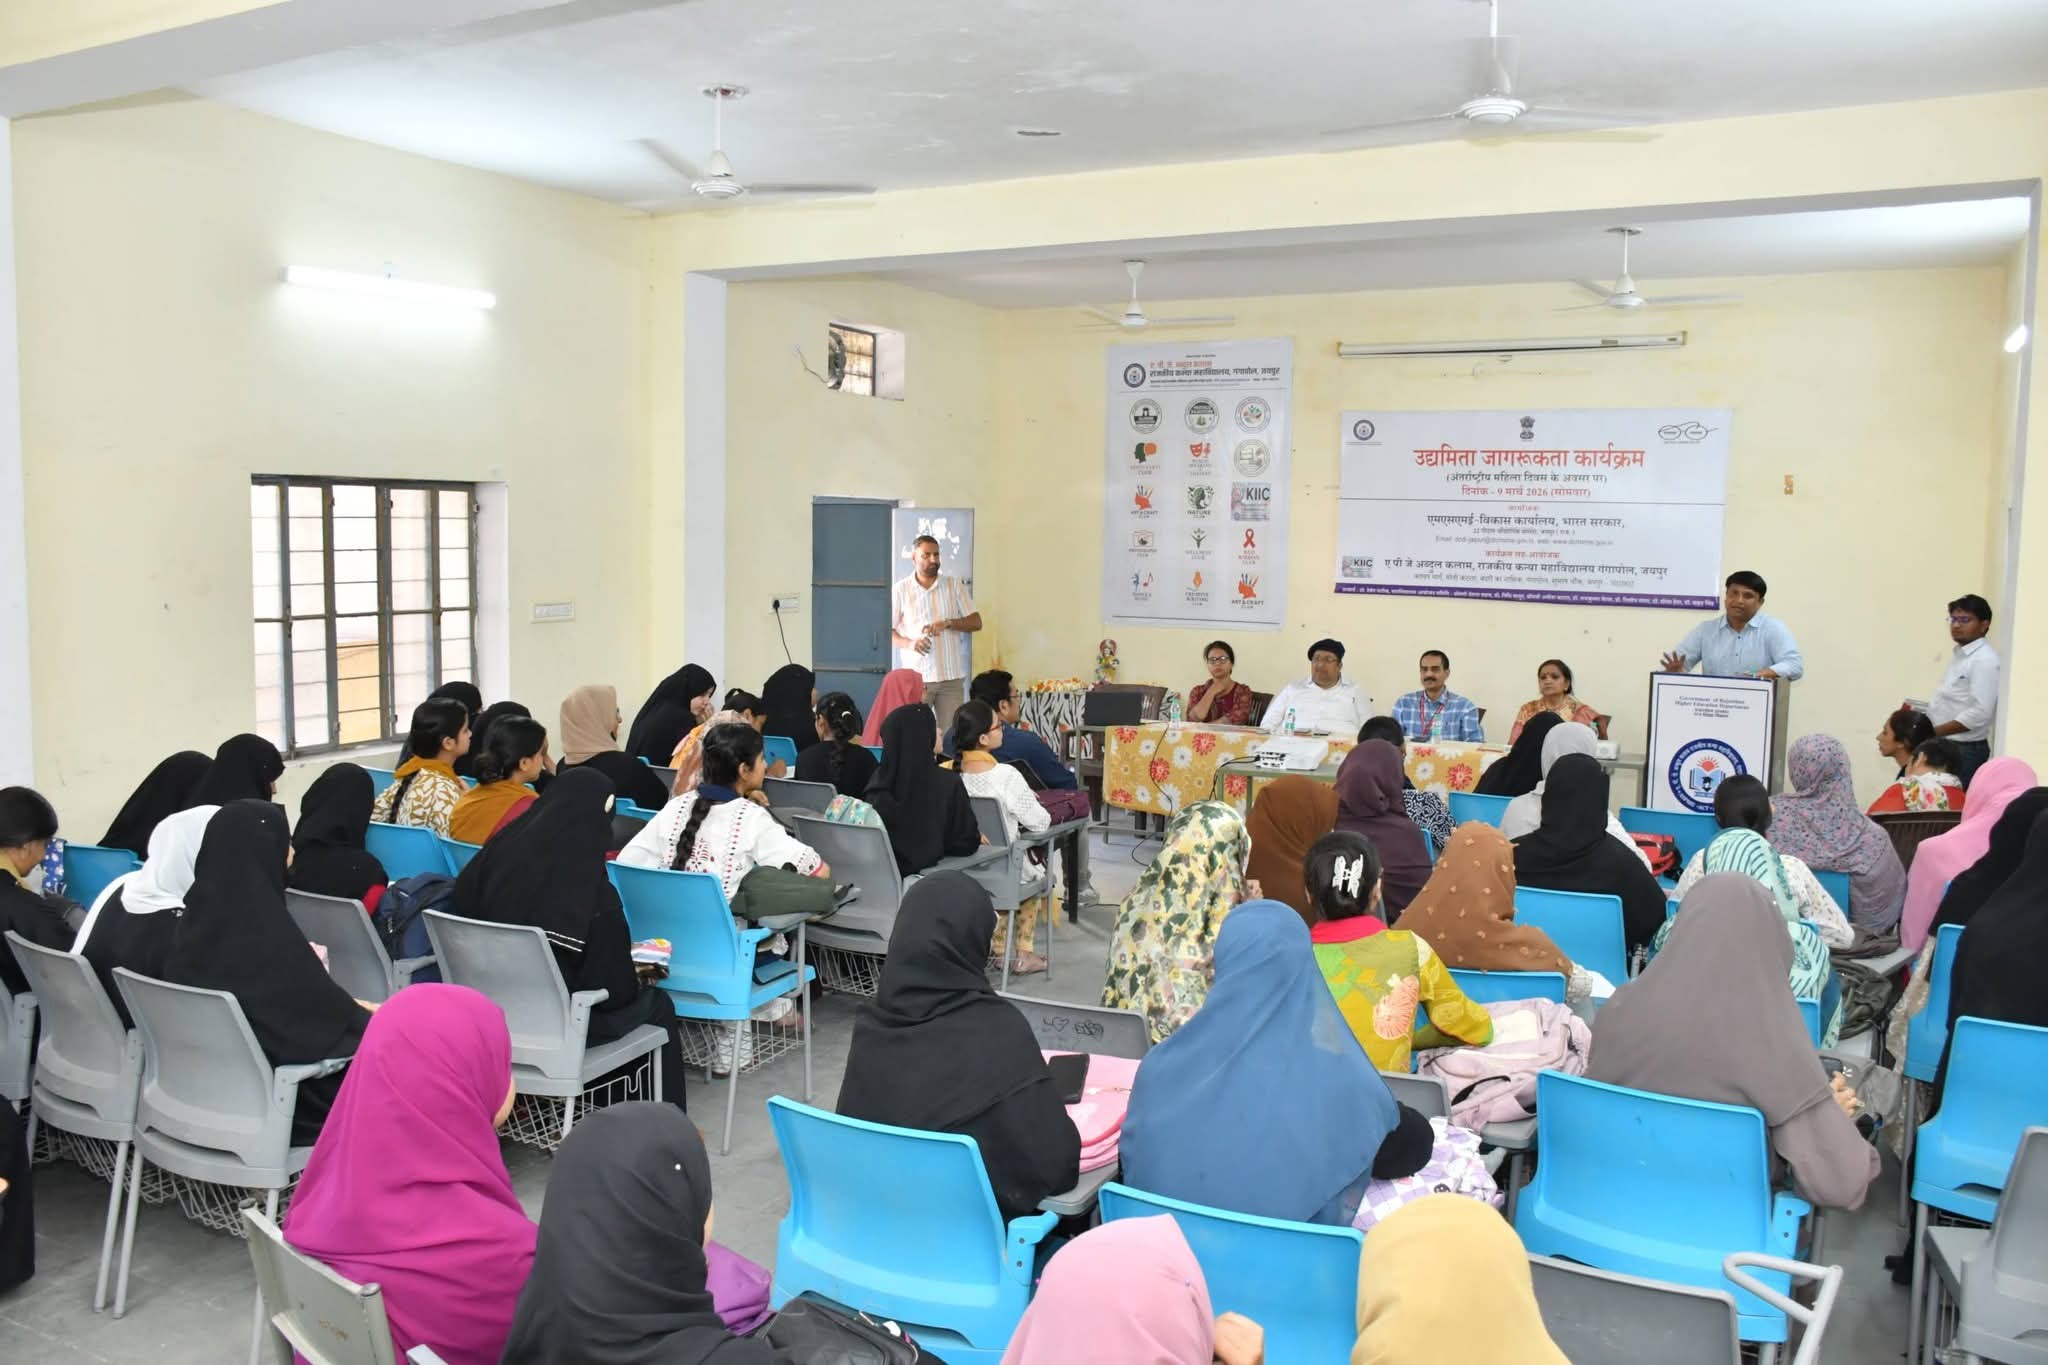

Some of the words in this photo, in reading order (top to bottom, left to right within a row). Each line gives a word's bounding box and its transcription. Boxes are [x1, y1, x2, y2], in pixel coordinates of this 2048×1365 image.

[1414, 443, 1477, 467] उद्यमिता
[1480, 449, 1569, 468] जागरूकता
[1573, 442, 1645, 470] कार्यक्रम
[1494, 472, 1521, 482] महिला
[1524, 472, 1547, 482] दिवस
[1550, 473, 1559, 482] के
[1246, 488, 1271, 501] KIIC
[1462, 485, 1488, 496] दिनांक
[1497, 488, 1503, 496] 9
[1506, 485, 1524, 496] मार्च
[1526, 488, 1548, 497] 2026
[1550, 487, 1591, 497] (सोमवार)
[1514, 514, 1558, 528] कार्यालय,
[1562, 518, 1586, 527] भारत
[1590, 518, 1625, 528] सरकार,
[1353, 559, 1373, 567] KIIC
[1385, 560, 1391, 569] ए
[1393, 557, 1402, 568] पी
[1405, 557, 1412, 568] जे
[1445, 561, 1475, 571] कलाम,
[1478, 560, 1512, 571] राजकीय
[1515, 563, 1537, 572] कन्या
[1540, 562, 1596, 574] महाविद्यालय
[1641, 567, 1669, 580] जयपुर
